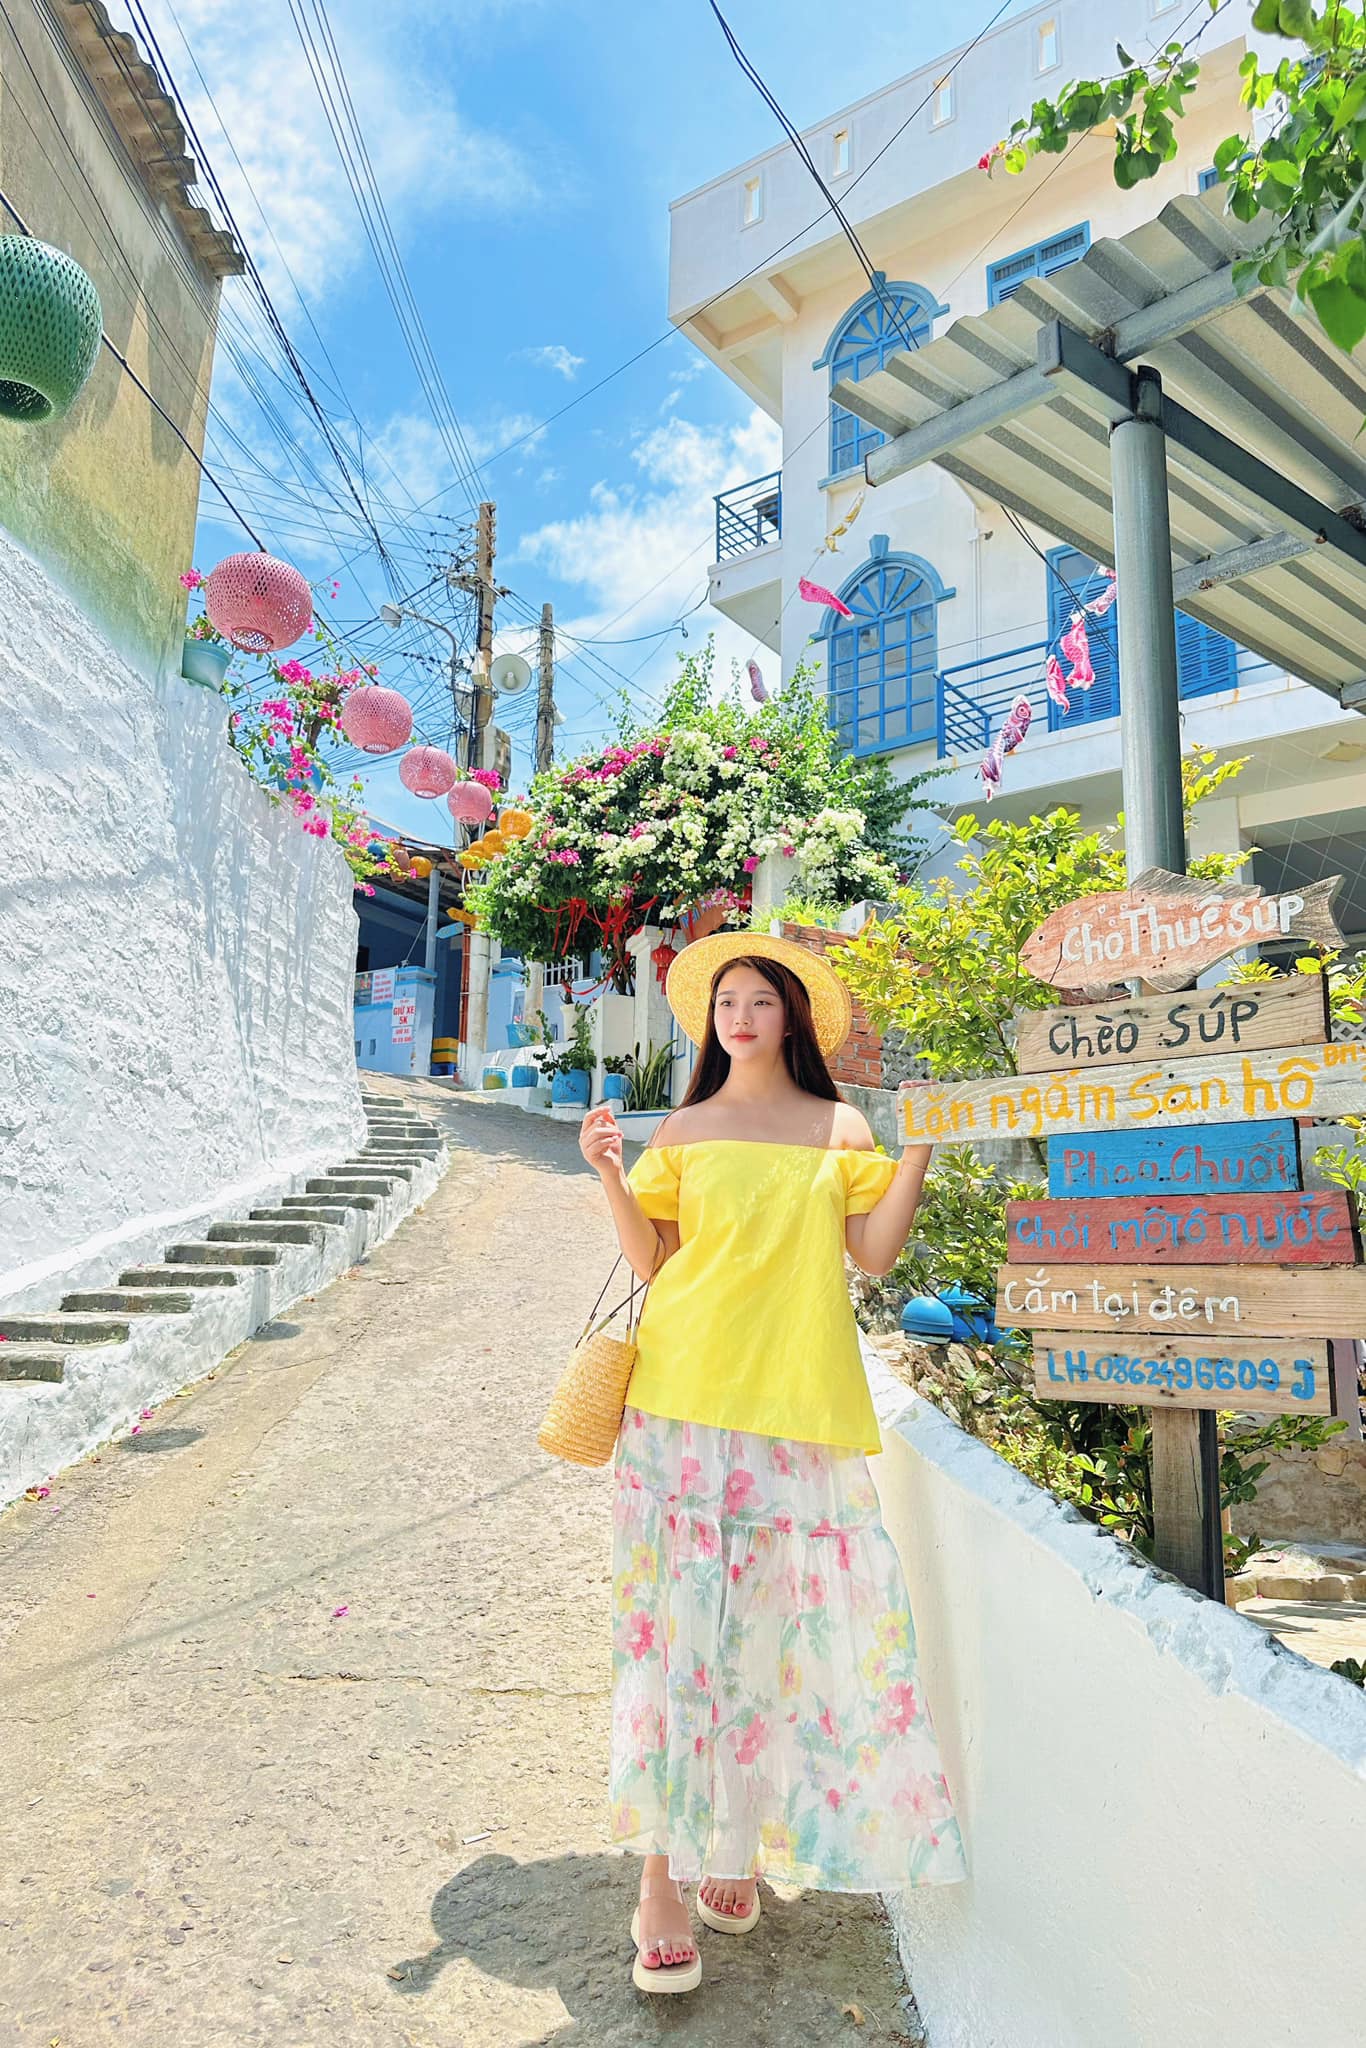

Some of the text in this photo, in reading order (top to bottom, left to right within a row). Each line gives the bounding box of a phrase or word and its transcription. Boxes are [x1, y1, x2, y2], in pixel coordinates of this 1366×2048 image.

[1062, 922, 1124, 965] Cho
[1120, 894, 1224, 955] Thuê
[904, 1092, 977, 1142] Lặn
[989, 1069, 1116, 1135] ngắm
[1241, 1057, 1320, 1116] hô
[1063, 1130, 1288, 1187] Phao Chuối
[1004, 1267, 1241, 1324] Cắm tại đêm
[1047, 1350, 1089, 1384] LH
[1094, 1355, 1281, 1391] 0862496609
